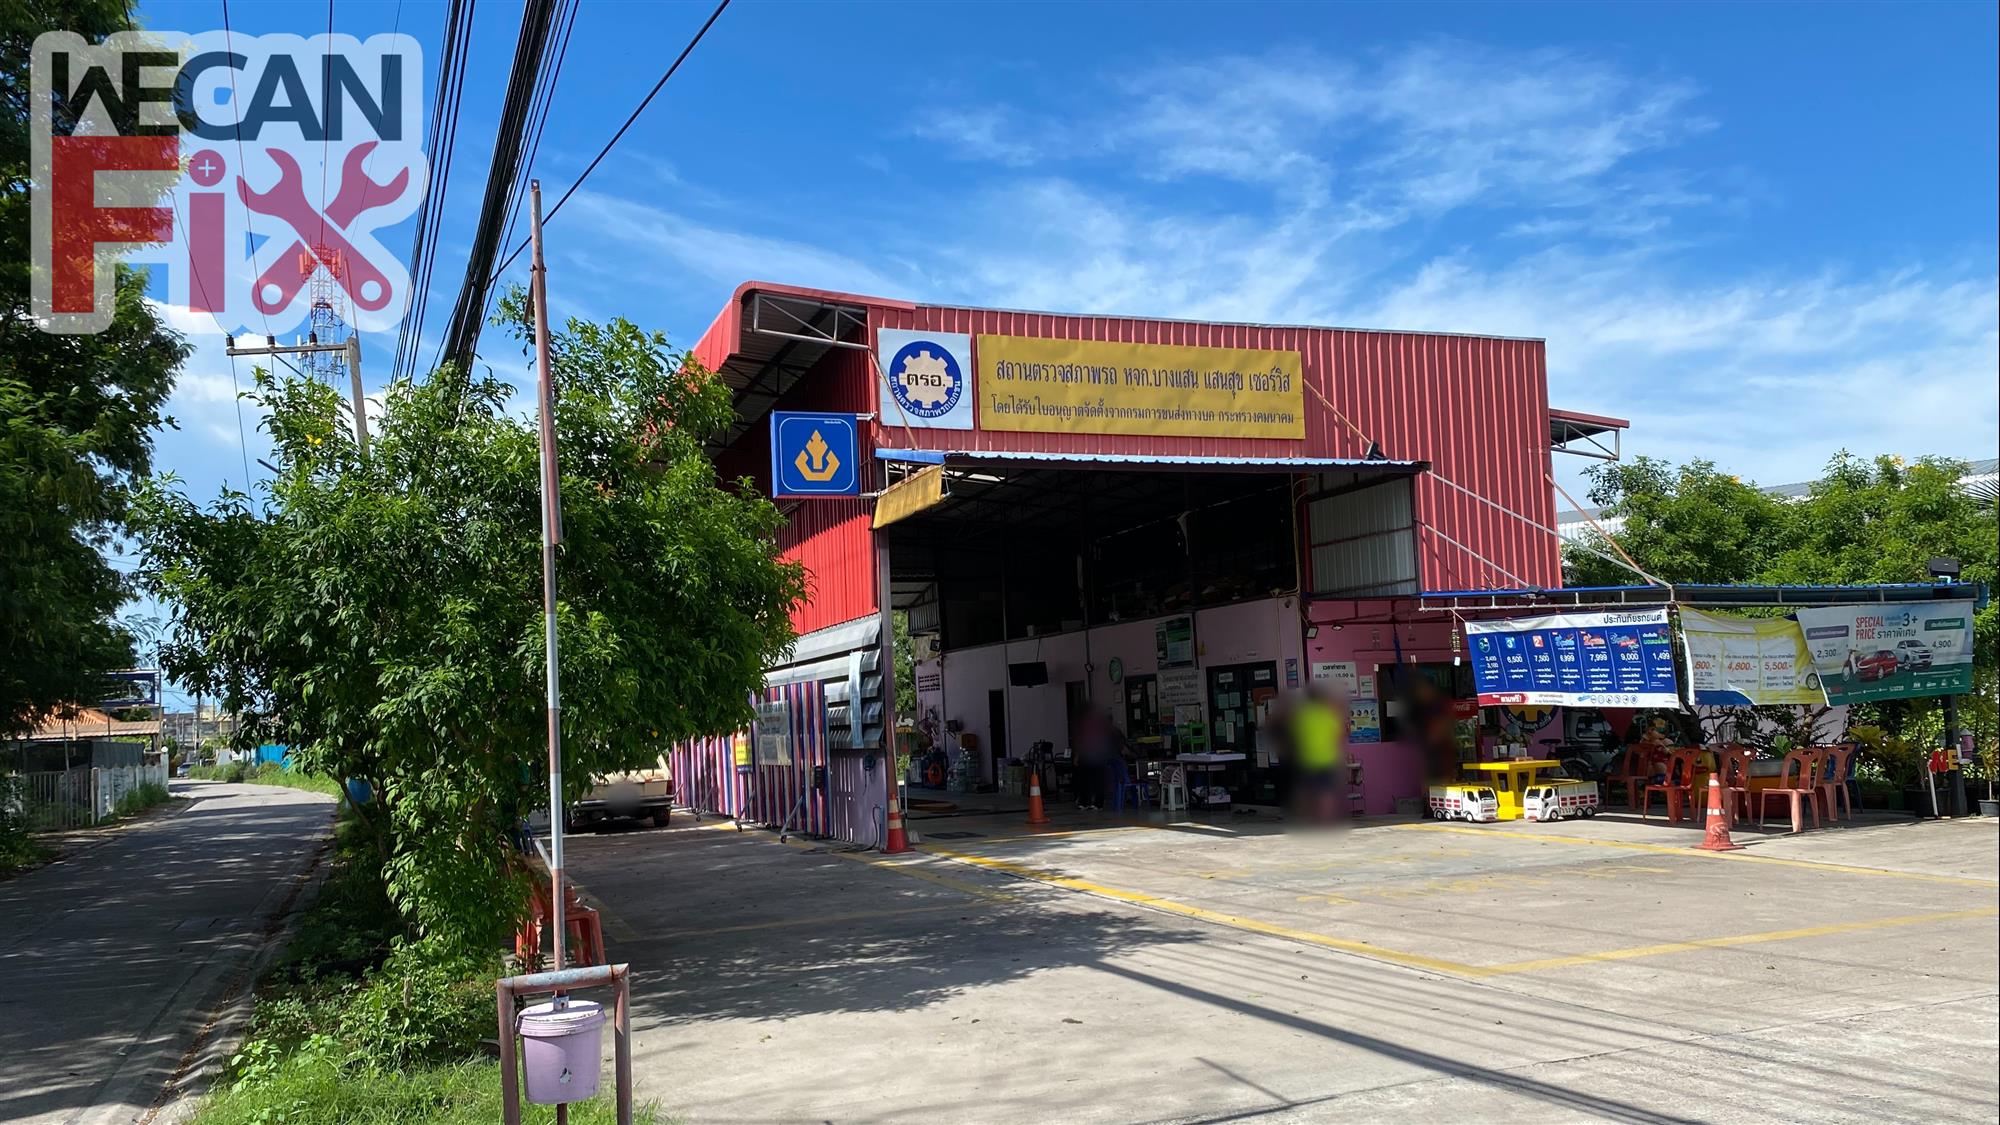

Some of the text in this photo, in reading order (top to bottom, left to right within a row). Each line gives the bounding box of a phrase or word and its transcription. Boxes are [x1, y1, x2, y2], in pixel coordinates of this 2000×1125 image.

[906, 373, 946, 388] ตรอ.
[996, 359, 1291, 399] สถานตรวจสภาพรถ หจก.บางแสน แสนสุข เซอร์วิส
[1218, 409, 1294, 425] กระทรวงคมนาคม
[1855, 615, 1884, 629] SPECIAL
[1855, 628, 1876, 640] PRICE
[1876, 628, 1917, 640] ราคาพิเศษ
[1932, 640, 1952, 649] 4,900
[1534, 655, 1550, 663] 7,500
[1590, 653, 1608, 663] 7,999
[1620, 653, 1639, 662] 9,000
[1817, 648, 1837, 659] 2,300
